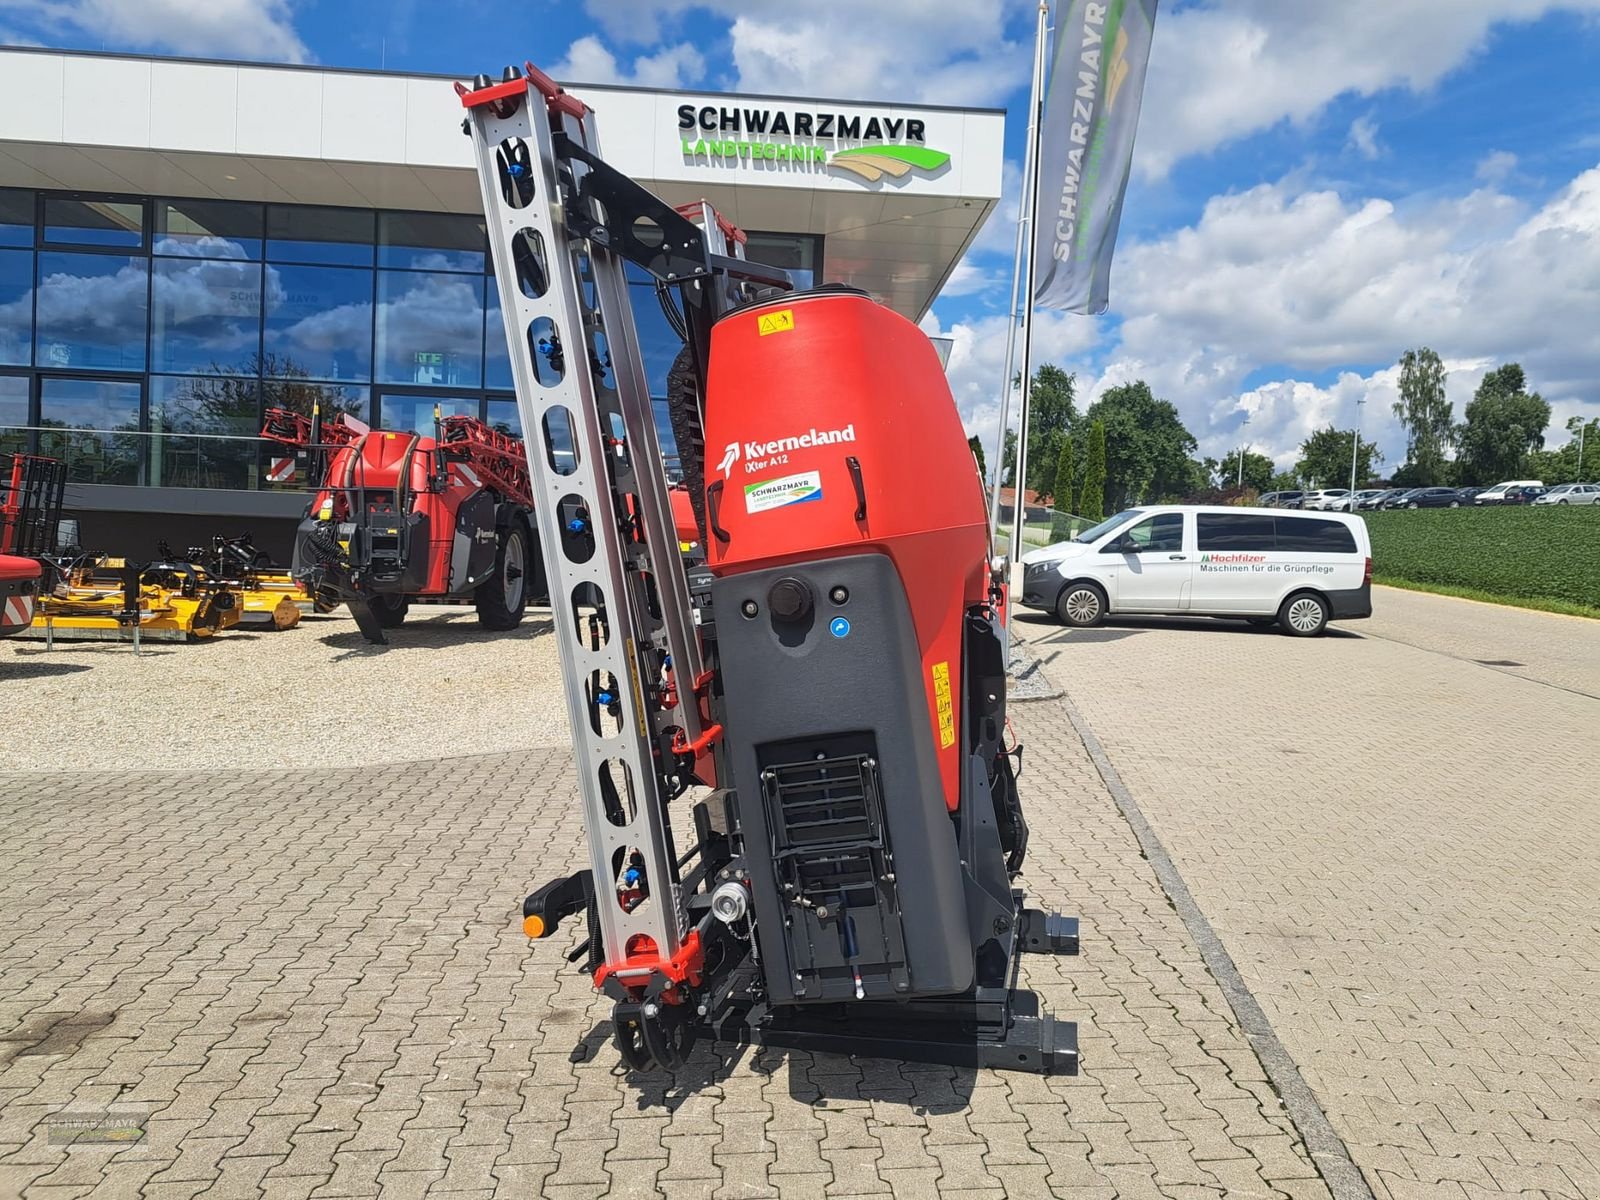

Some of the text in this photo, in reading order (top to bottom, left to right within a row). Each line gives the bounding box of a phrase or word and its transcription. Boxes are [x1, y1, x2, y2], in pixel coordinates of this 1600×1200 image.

[678, 105, 925, 141] SCHWARZMAYR
[1053, 2, 1106, 262] SCHWARZMAYR
[682, 138, 827, 162] LANDTECHNIK
[744, 424, 856, 460] Kverneland
[770, 454, 789, 466] A12
[751, 480, 809, 498] SCHWARZMAYR
[1210, 554, 1266, 563] Hochfilzer
[1252, 564, 1264, 572] für
[1267, 564, 1281, 572] die
[1284, 565, 1334, 574] Grünpflege
